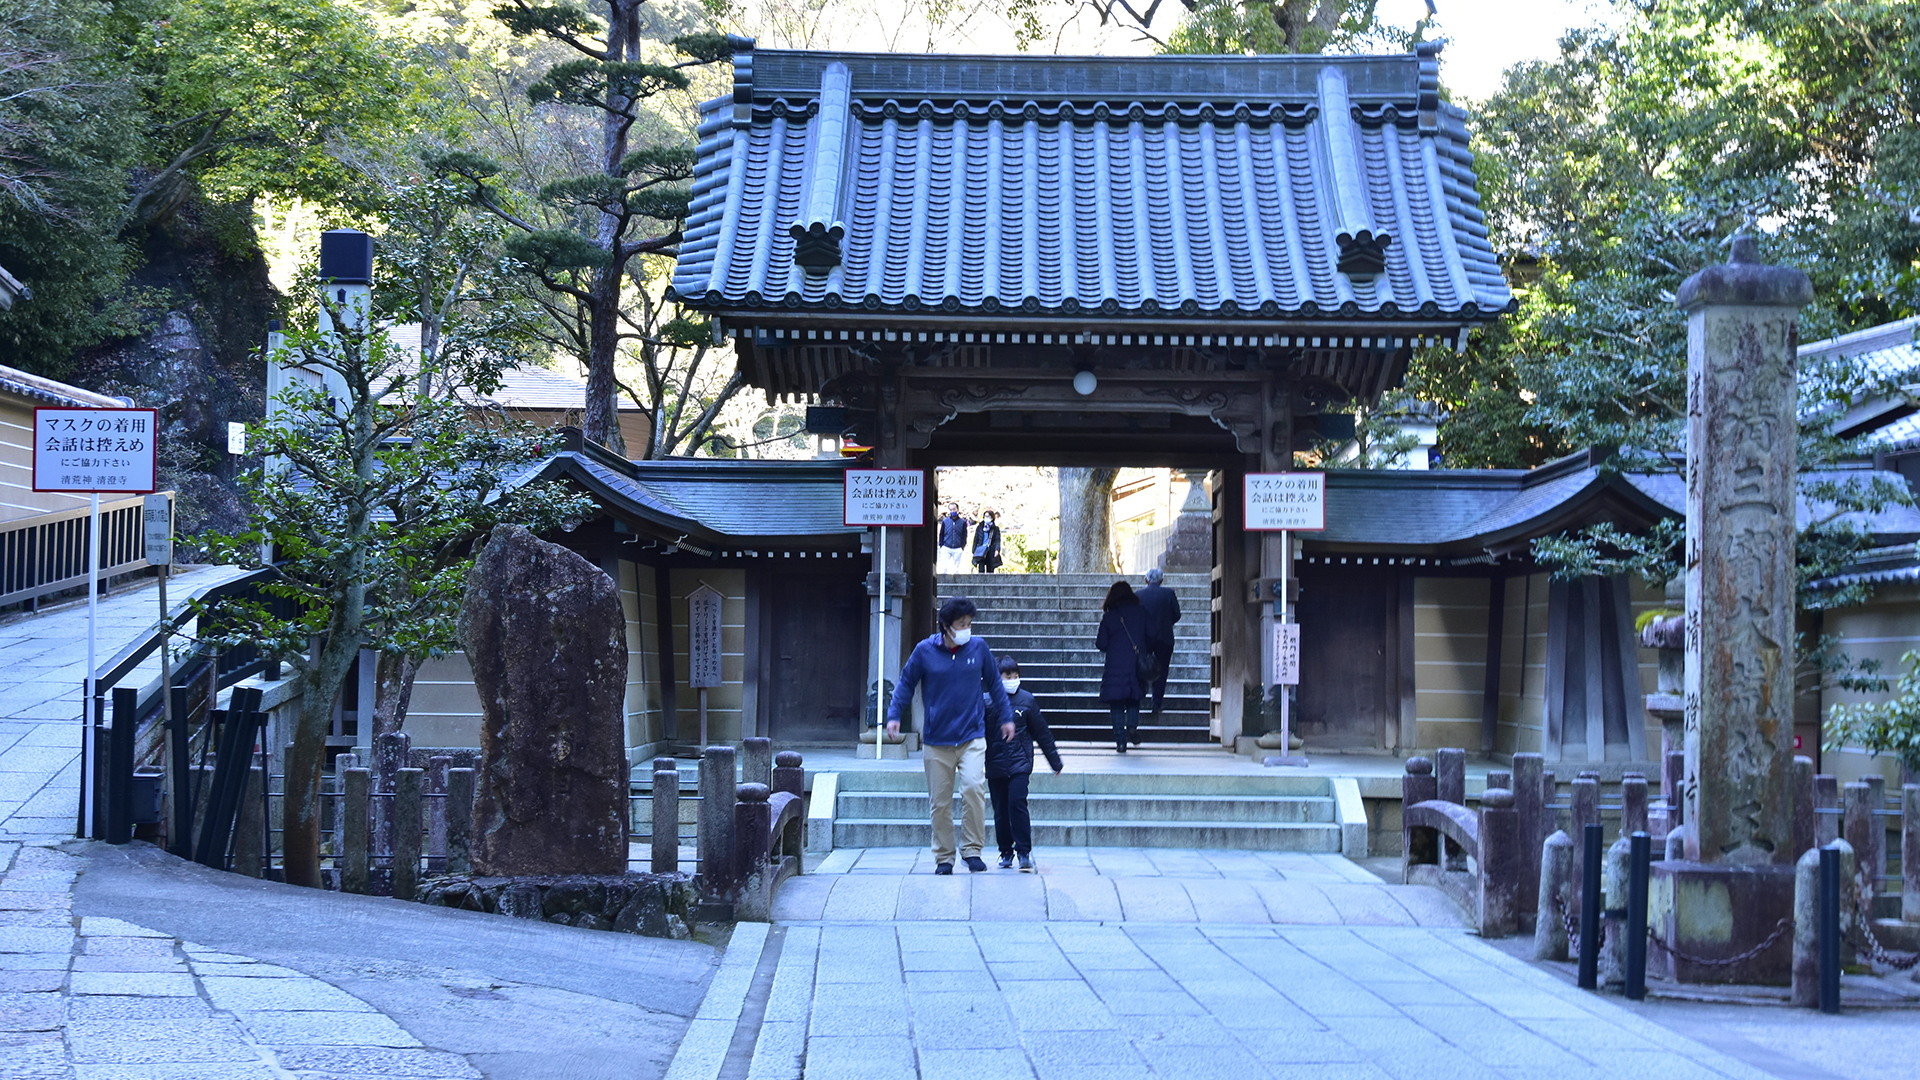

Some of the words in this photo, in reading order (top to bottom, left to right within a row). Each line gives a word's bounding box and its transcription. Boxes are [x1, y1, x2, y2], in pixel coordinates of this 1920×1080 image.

[45, 418, 146, 433] マスクの着用
[45, 436, 145, 452] 会話は控えめ
[61, 458, 131, 468] にご協力下さい
[61, 475, 92, 485] 清荒神
[97, 475, 128, 485] 清澄寺
[851, 475, 918, 486] マスクの着用
[1251, 479, 1318, 490] マスクの着用
[852, 488, 917, 499] 会話は控えめ
[1251, 492, 1317, 503] 会話は控えめ
